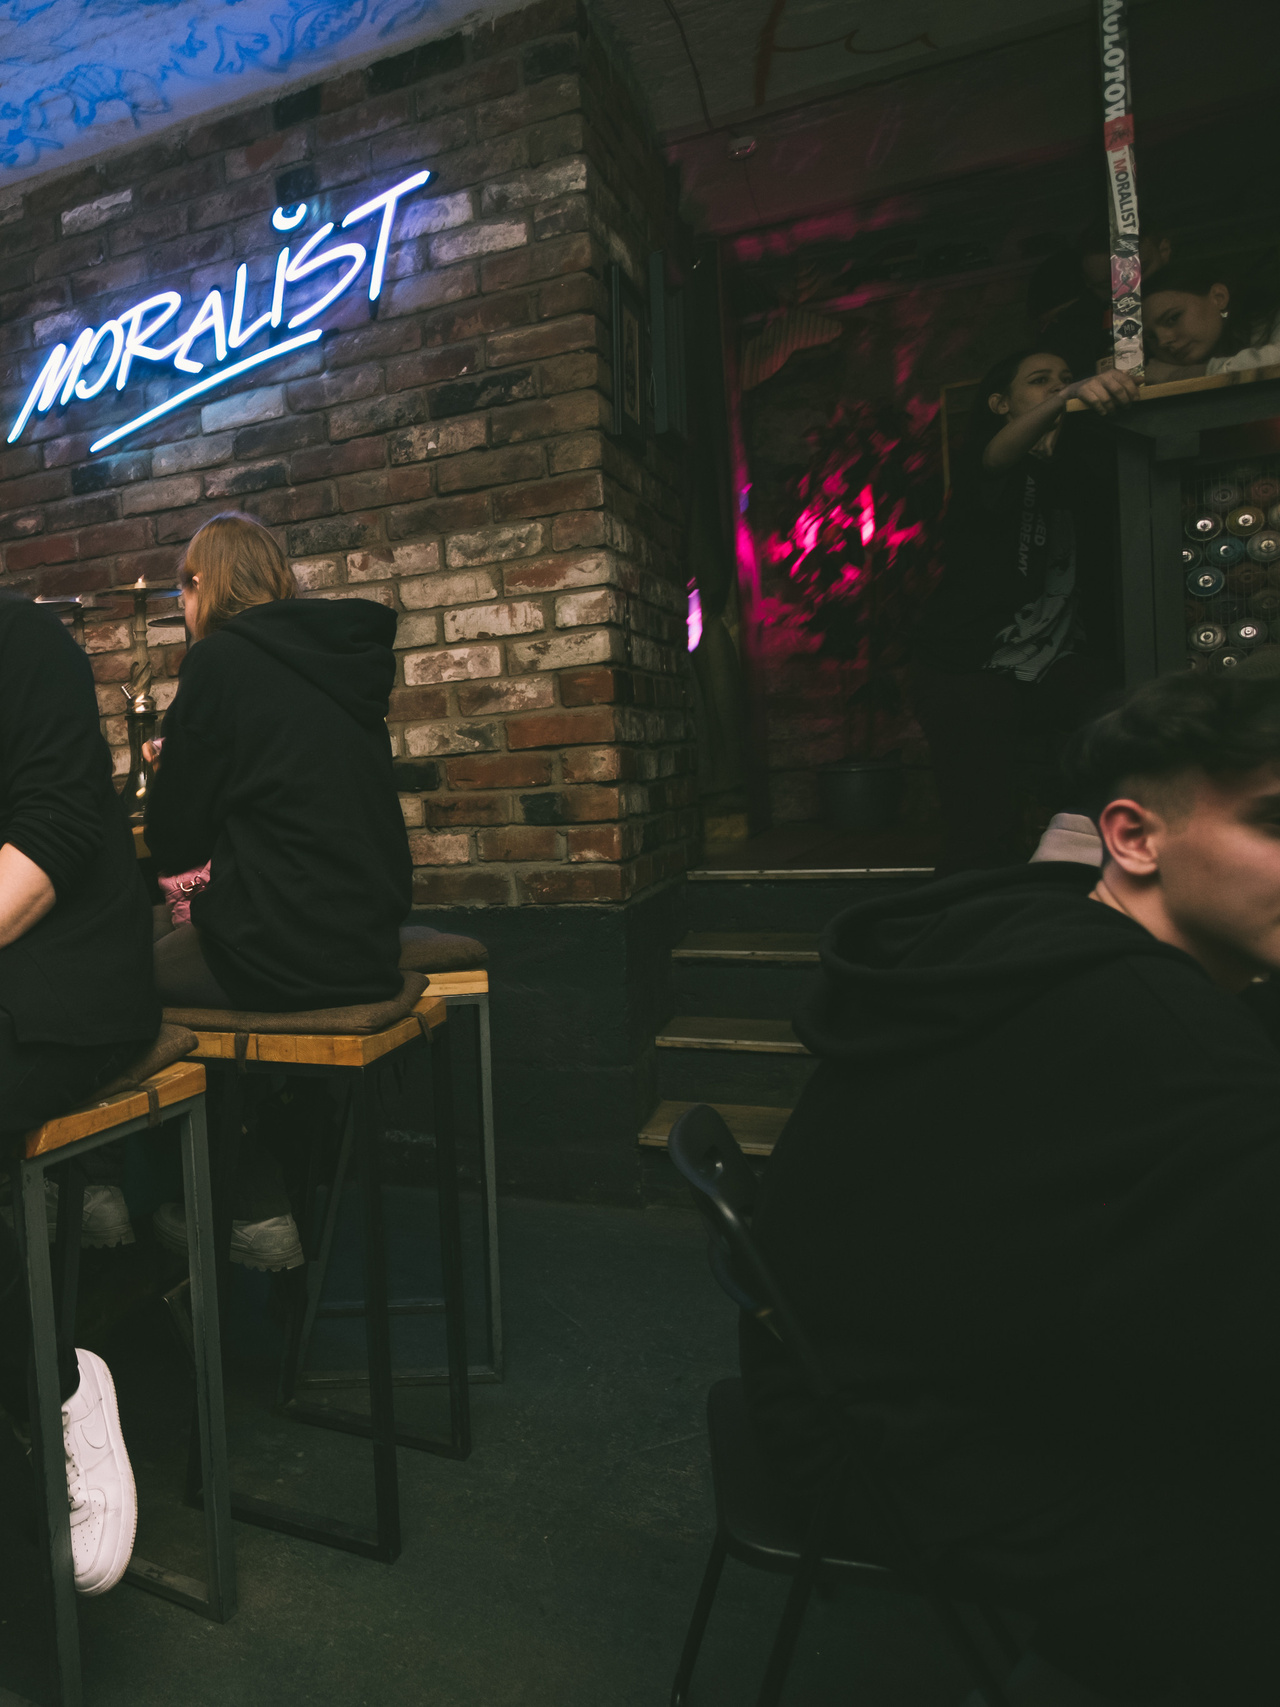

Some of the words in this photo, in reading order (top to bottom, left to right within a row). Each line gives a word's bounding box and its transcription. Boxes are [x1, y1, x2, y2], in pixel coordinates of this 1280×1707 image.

[7, 170, 432, 444] MORALIST
[1023, 475, 1036, 508] AND
[1018, 511, 1034, 576] DREAMY
